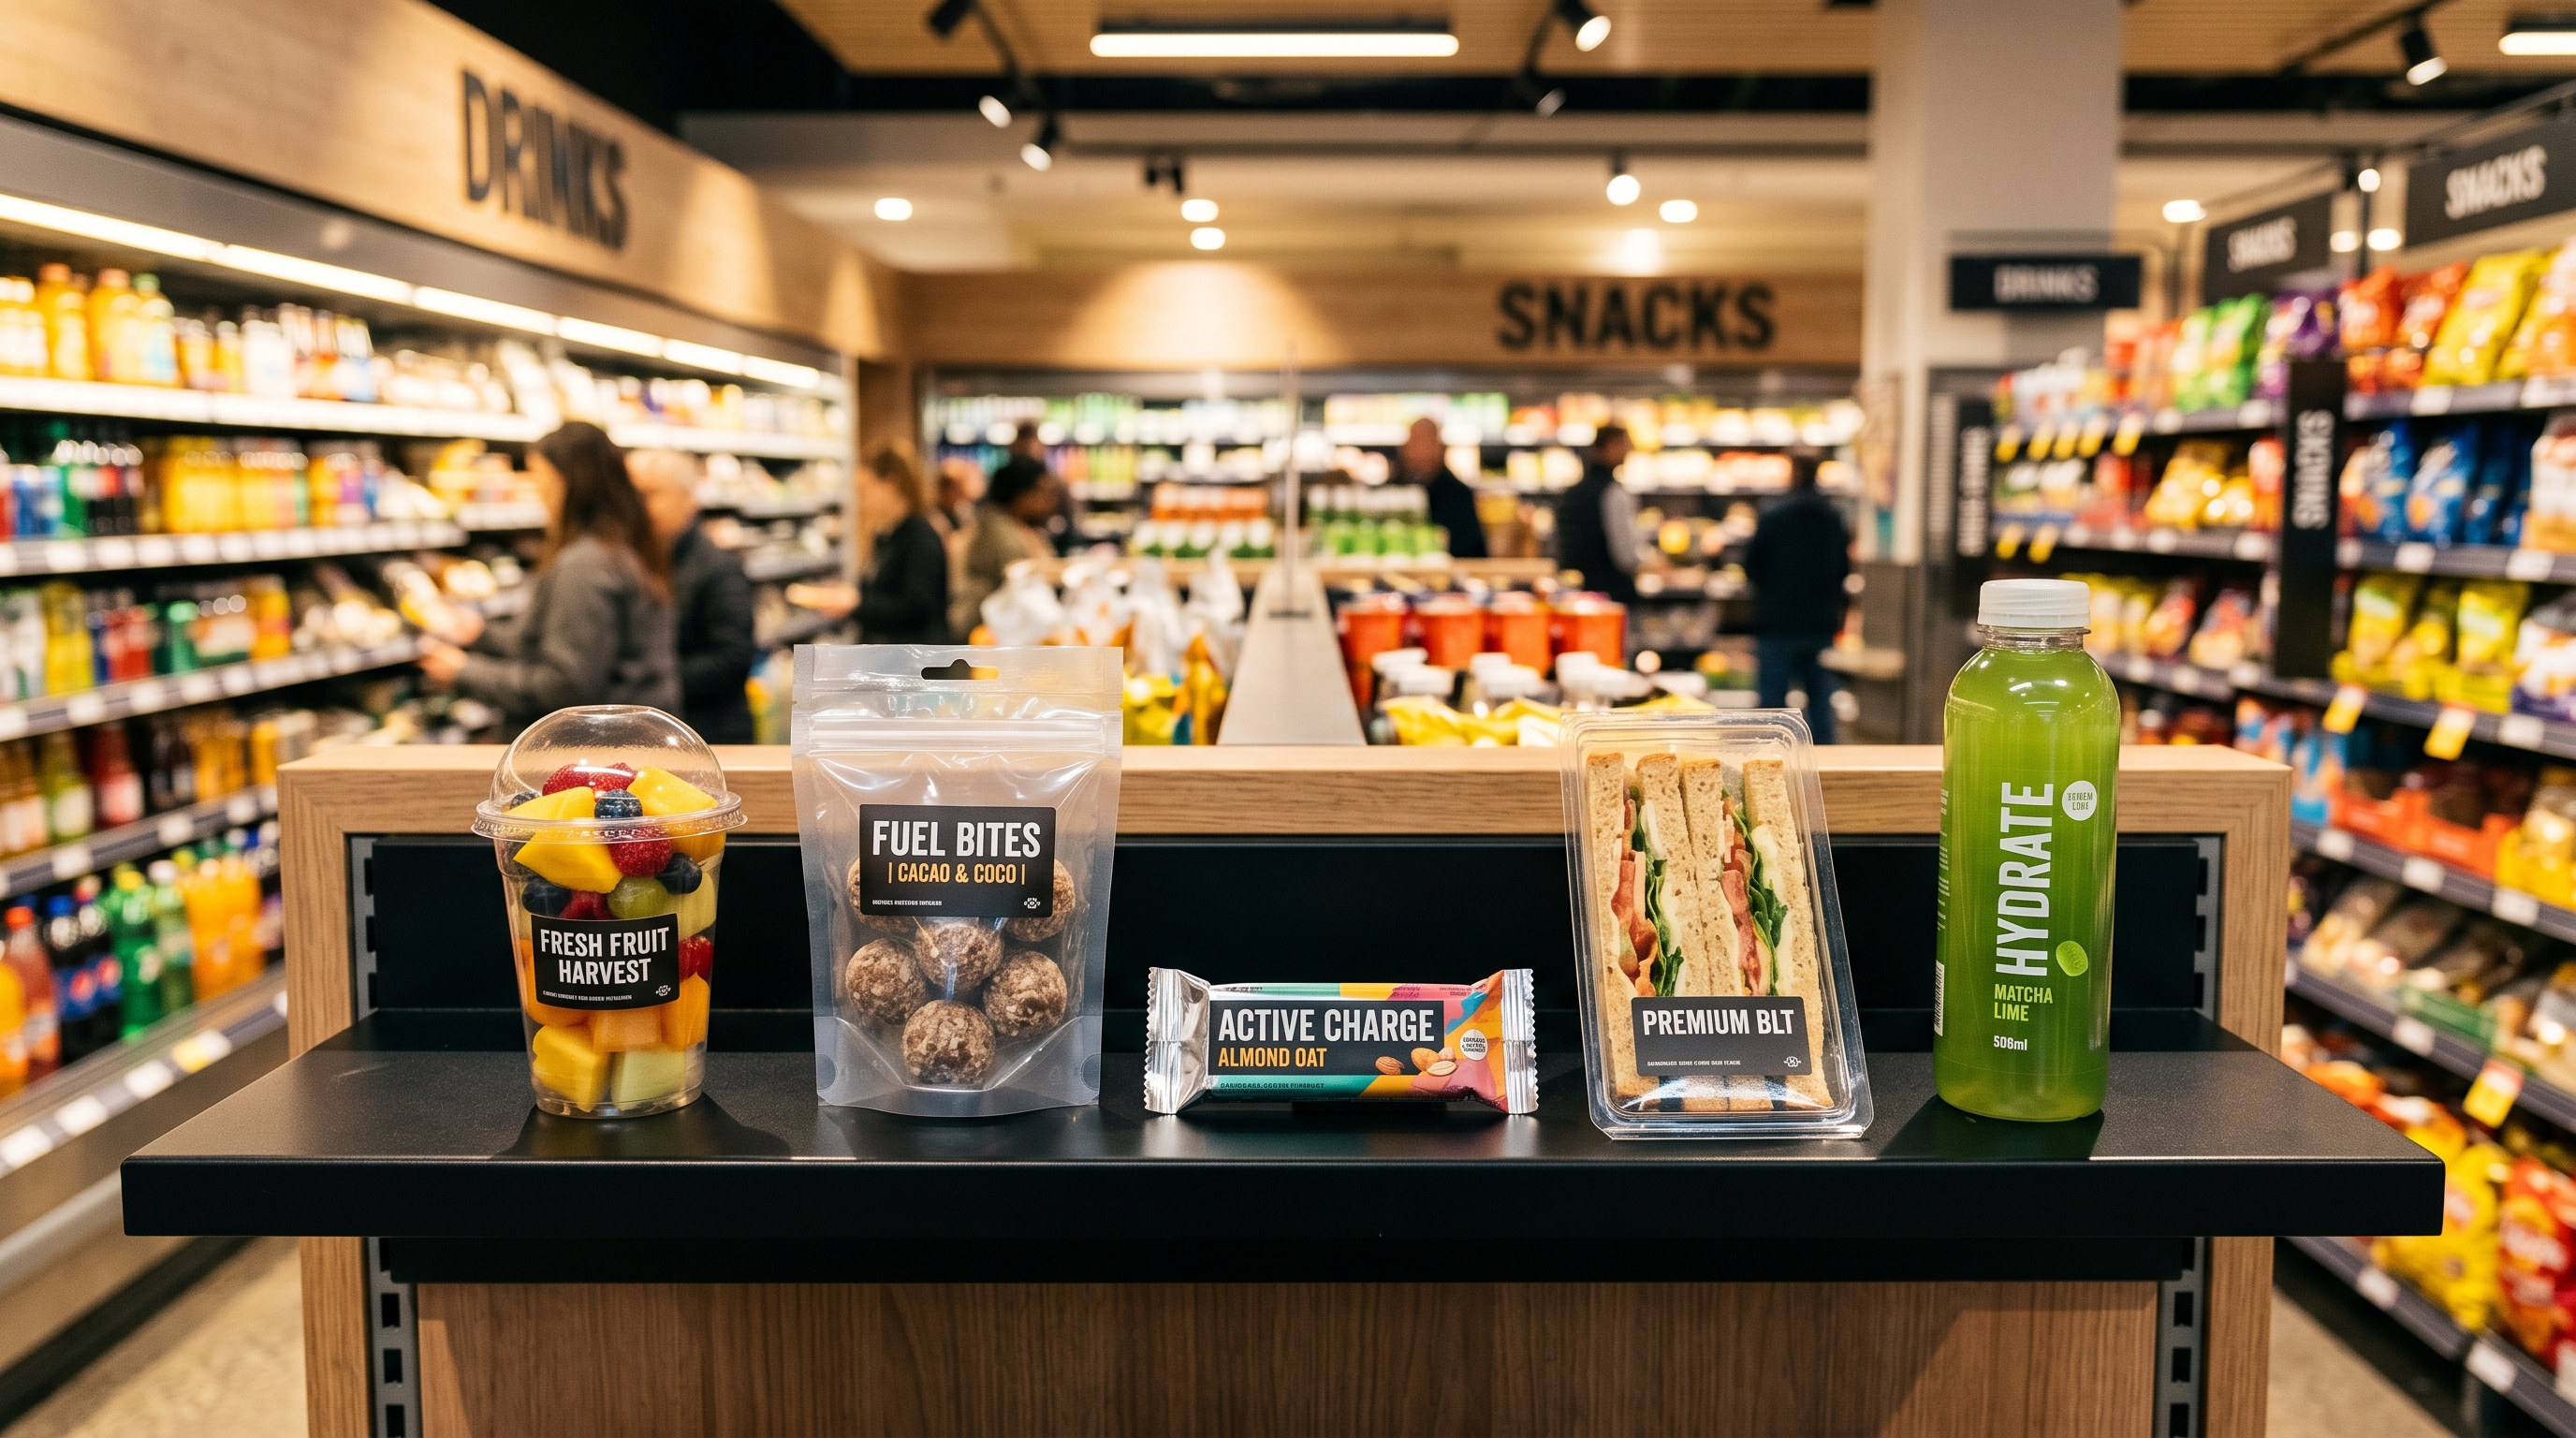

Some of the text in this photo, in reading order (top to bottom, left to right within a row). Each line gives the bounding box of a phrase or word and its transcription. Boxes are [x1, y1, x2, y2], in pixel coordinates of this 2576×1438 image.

[1498, 281, 1777, 349] SNACKS
[872, 820, 1041, 858] FUEL BITES
[898, 862, 1017, 884] CACAO & COCO
[1996, 782, 2054, 976] HYDRATE
[540, 927, 670, 957] FRESH FRUIT
[558, 958, 651, 985] HARVEST
[1994, 983, 2054, 1004] MATCHA
[1218, 1008, 1435, 1042] ACTIVE CHARGE
[1642, 1009, 1794, 1035] PREMIUM BLT
[1994, 1002, 2029, 1022] LIME
[1218, 1047, 1327, 1067] ALMOND OAT
